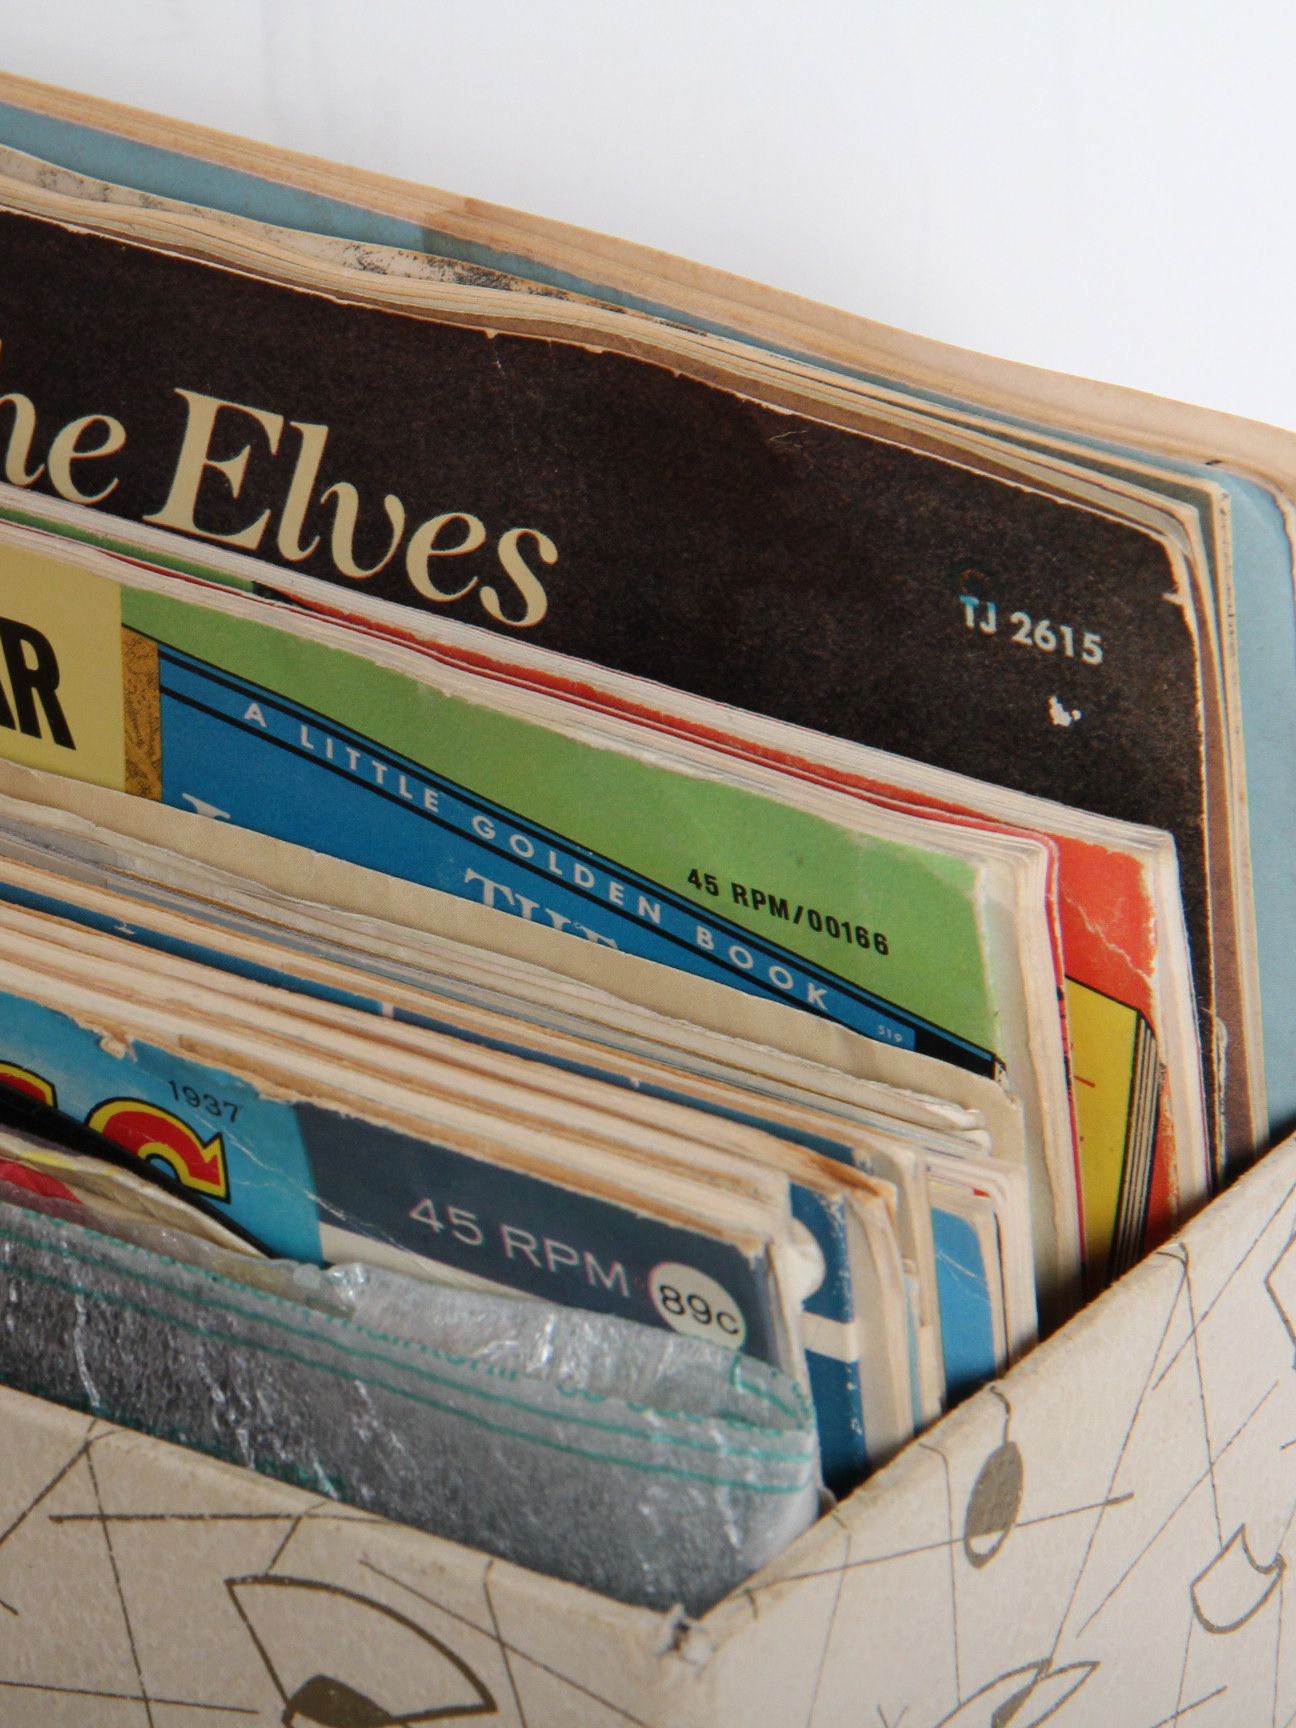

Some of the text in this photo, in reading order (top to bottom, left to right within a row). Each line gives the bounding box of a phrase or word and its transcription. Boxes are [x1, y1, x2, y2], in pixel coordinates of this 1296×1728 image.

[142, 387, 559, 627] Elves
[958, 593, 1104, 666] TJ 2615
[243, 702, 268, 728] A
[300, 724, 440, 813] LITTLE
[471, 814, 662, 925] GOLDEN
[695, 925, 829, 1011] BOOK
[687, 868, 890, 956] 45 RPM/00166
[167, 1080, 240, 1123] 1937
[408, 1197, 631, 1298] 45 RPM
